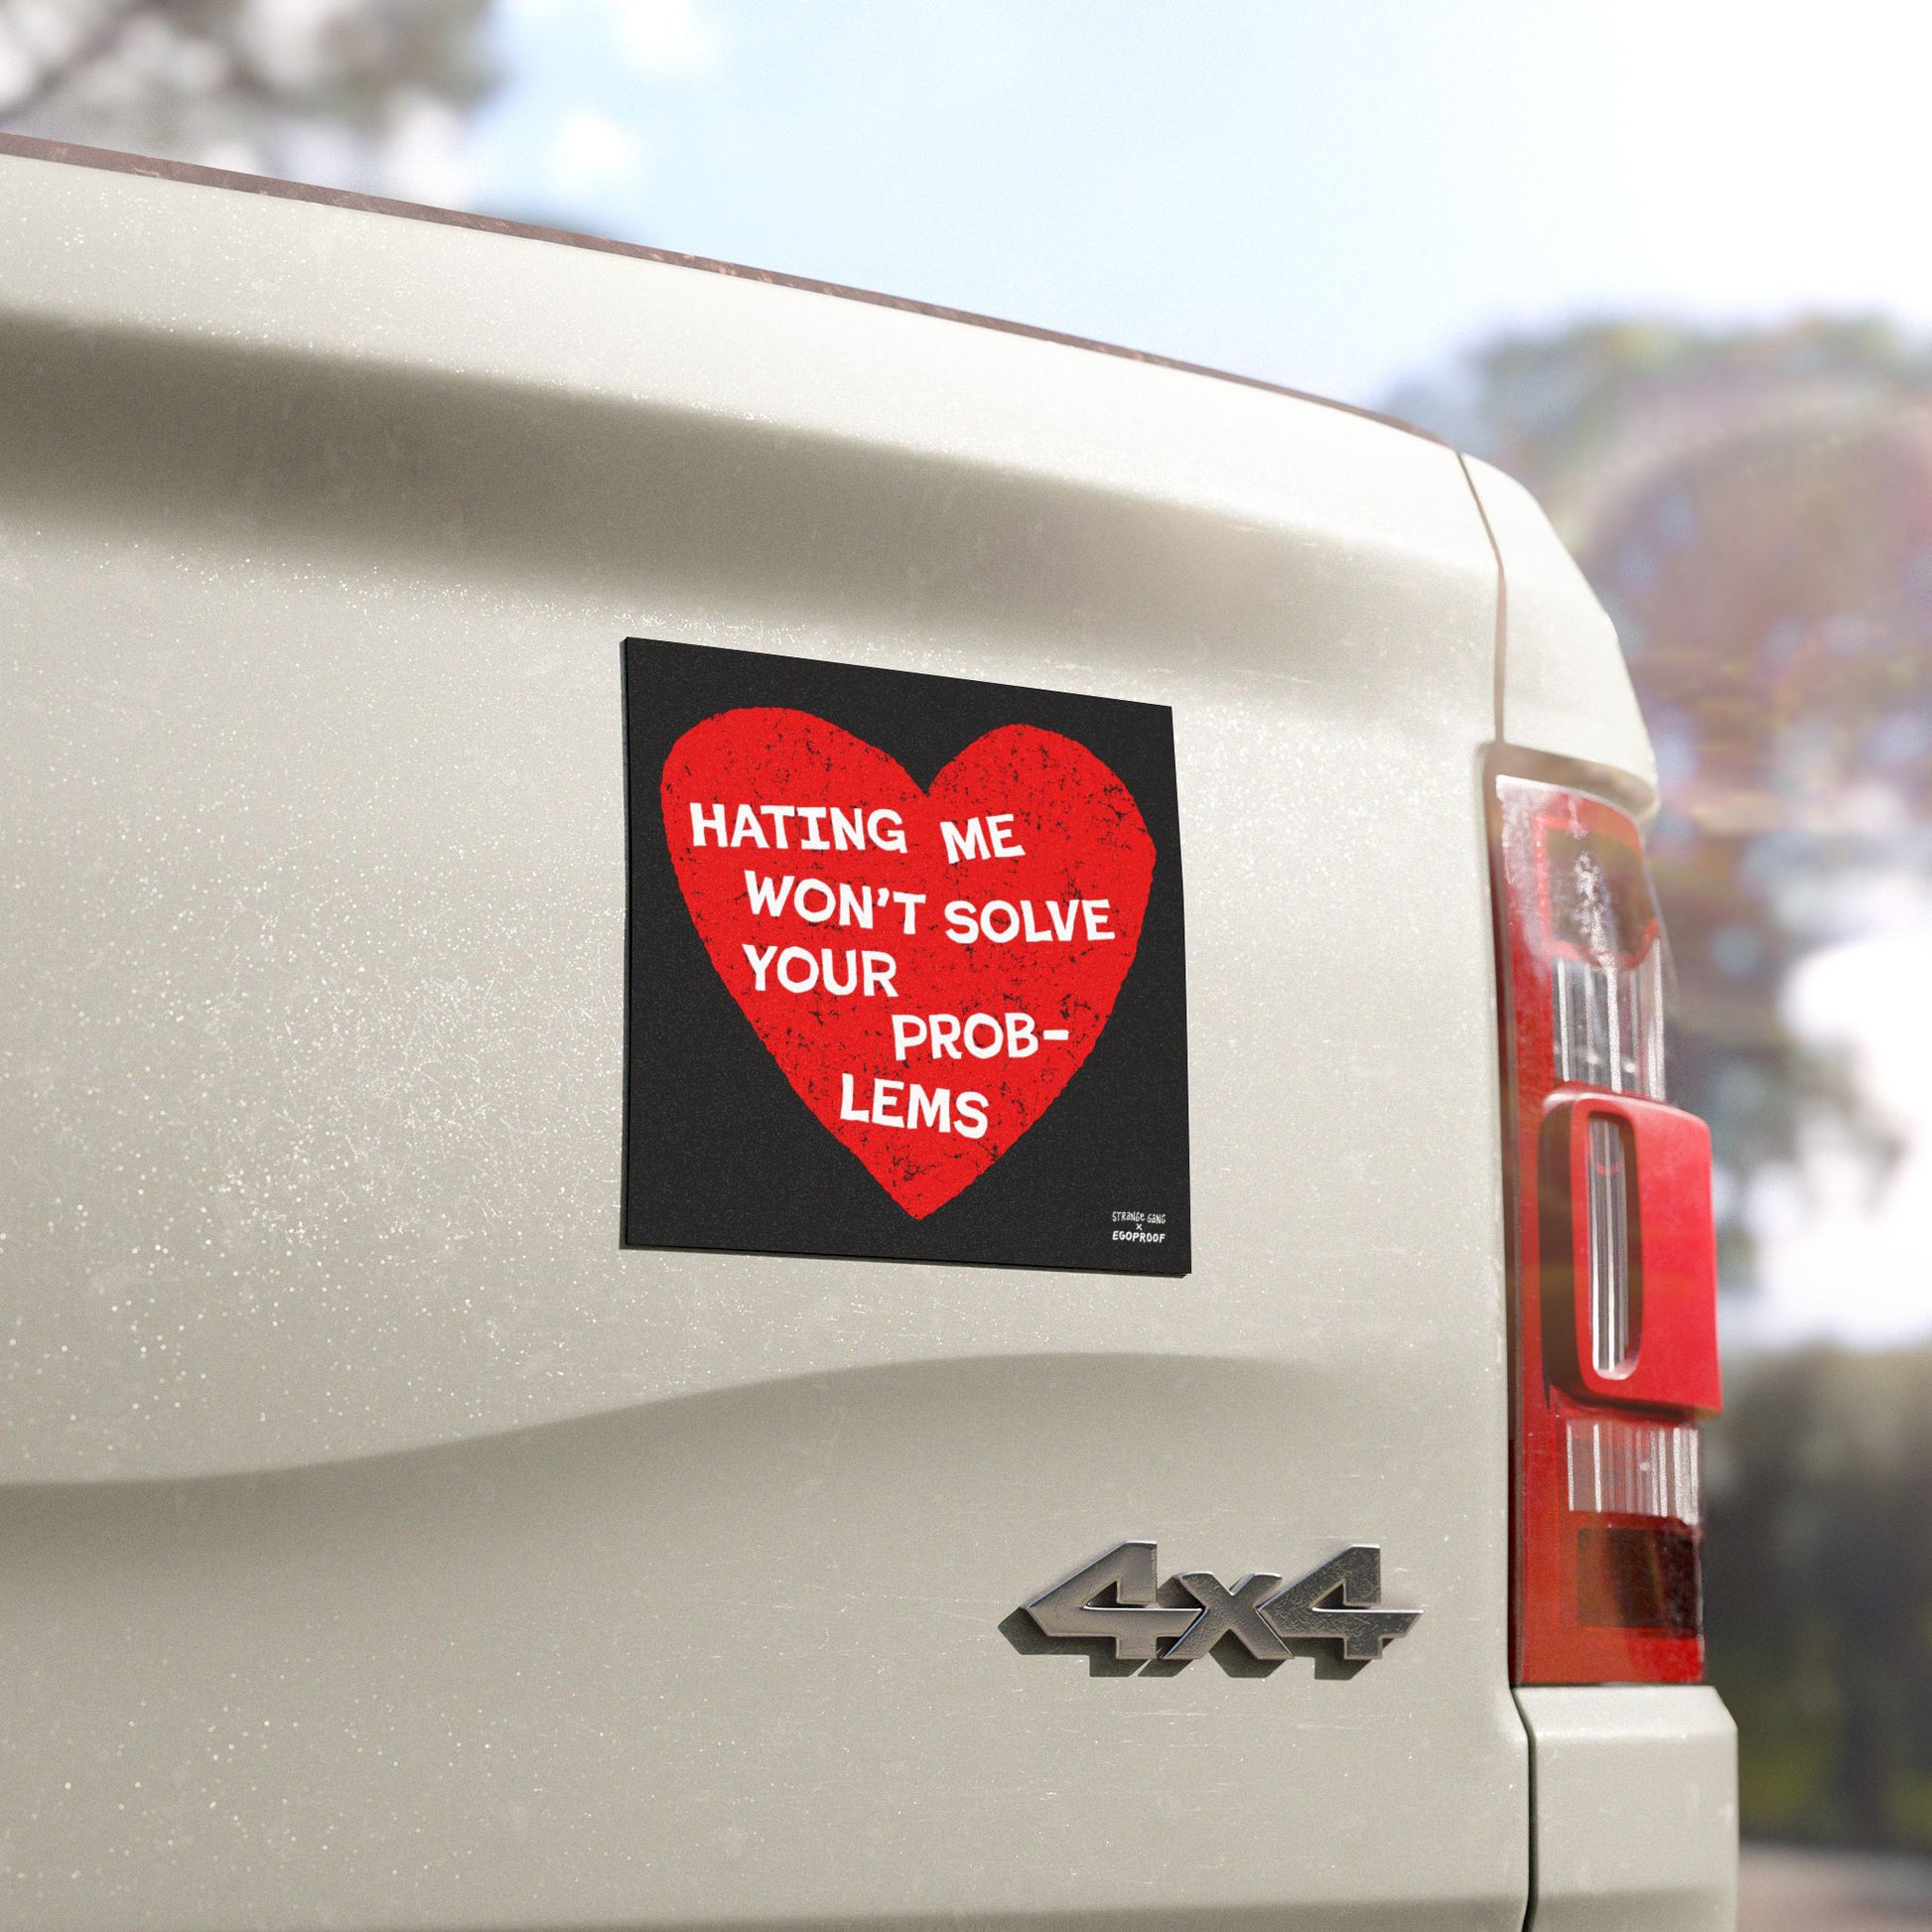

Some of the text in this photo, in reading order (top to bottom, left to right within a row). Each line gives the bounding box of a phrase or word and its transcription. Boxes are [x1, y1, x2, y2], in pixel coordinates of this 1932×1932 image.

[689, 802, 1026, 865] HATING ME
[944, 898, 1116, 944] SOLVE
[742, 943, 899, 998] YOUR
[891, 1012, 1070, 1061] PROB-
[840, 1072, 989, 1140] LEMS
[1112, 1230, 1166, 1243] EGOPROOF
[1025, 1540, 1425, 1660] 4x4
